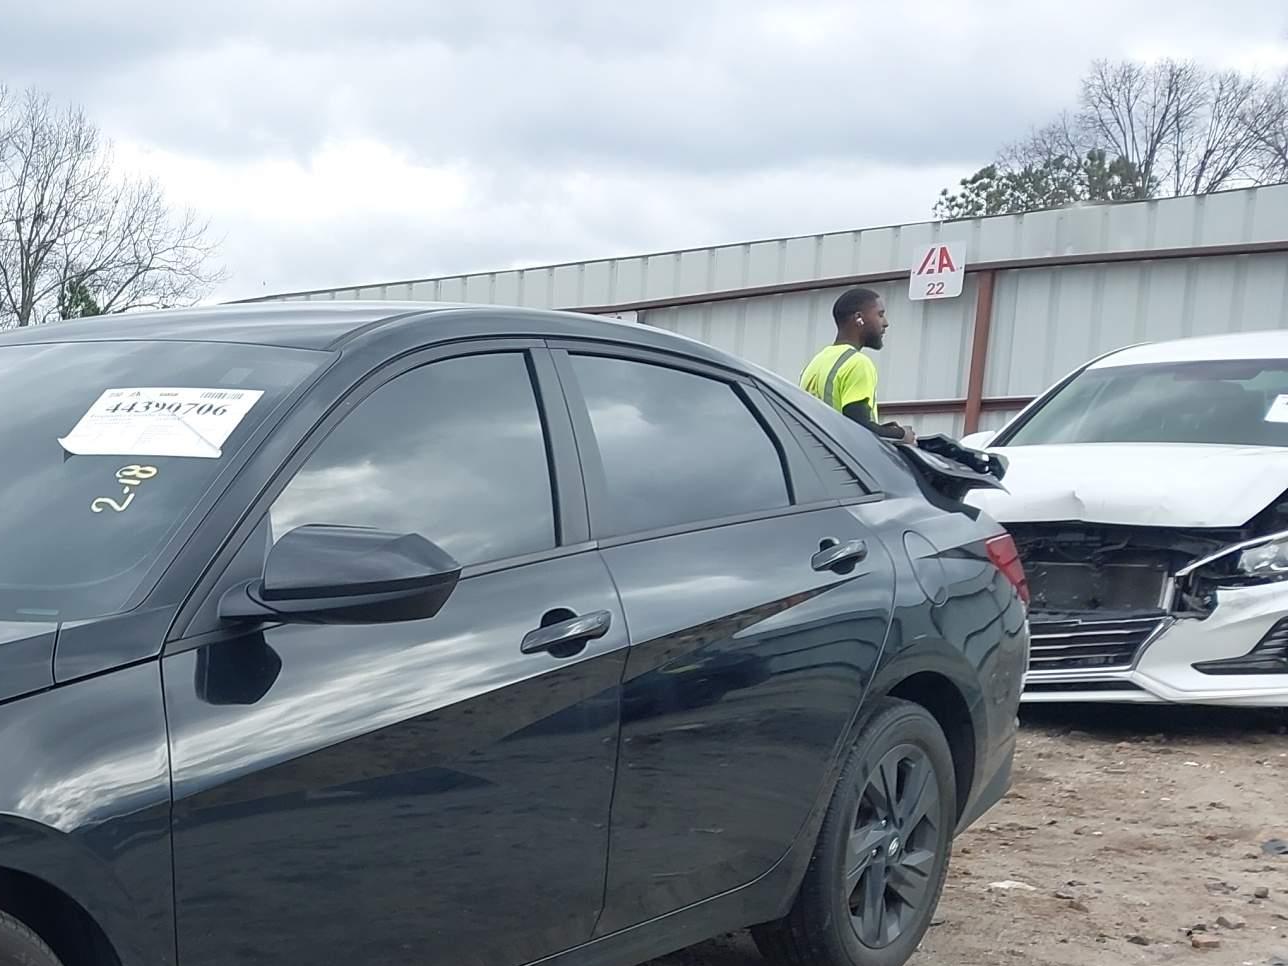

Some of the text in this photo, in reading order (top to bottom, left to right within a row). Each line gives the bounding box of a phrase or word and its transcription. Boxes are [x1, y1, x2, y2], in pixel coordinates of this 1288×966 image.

[926, 282, 944, 295] 22
[105, 400, 230, 416] 44390706
[90, 464, 158, 512] 2-18
